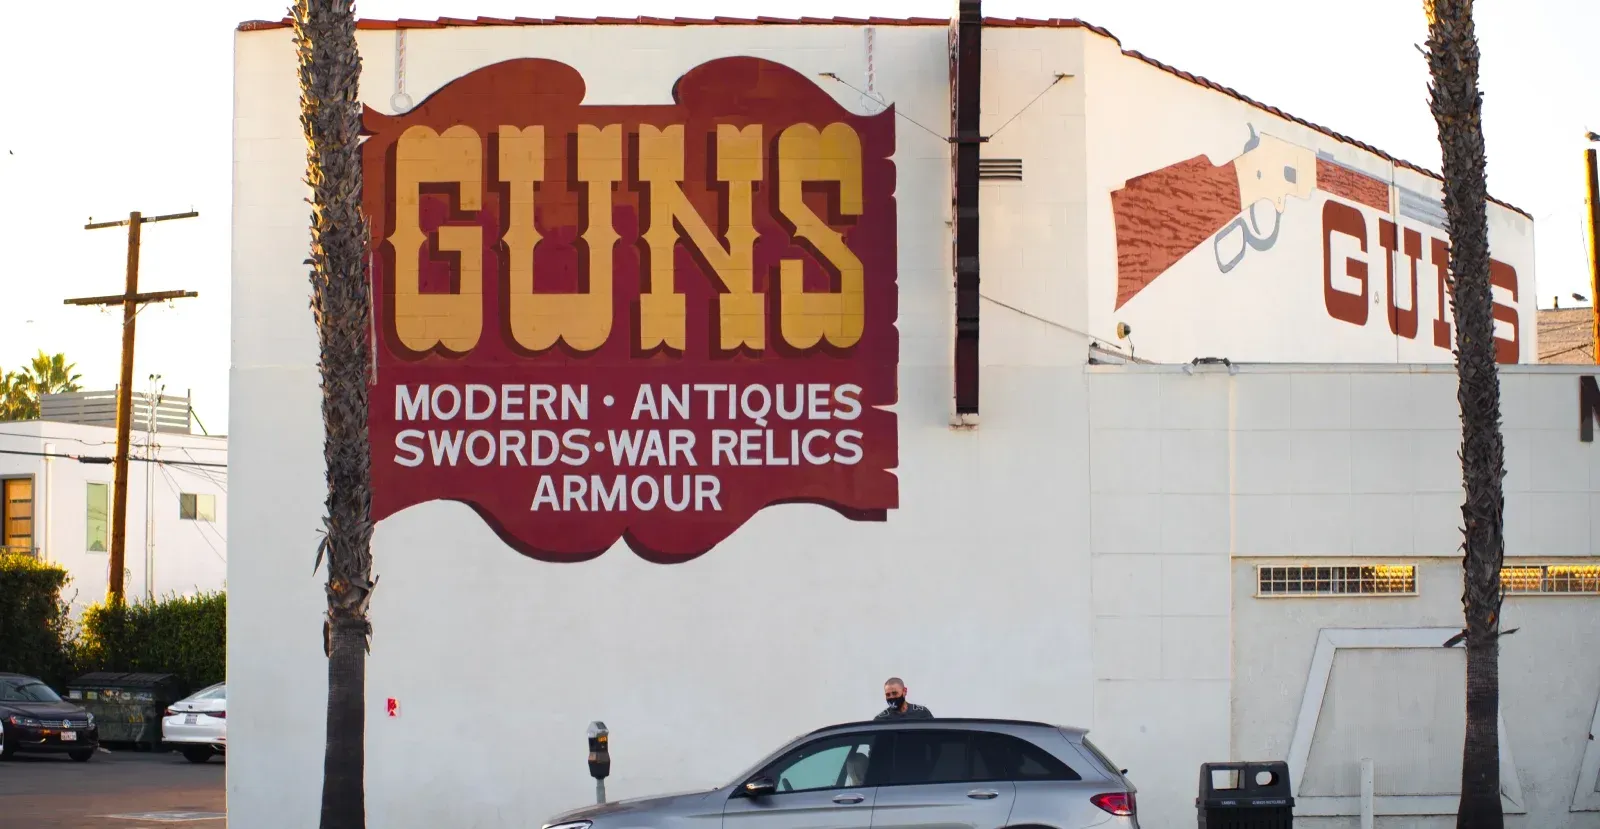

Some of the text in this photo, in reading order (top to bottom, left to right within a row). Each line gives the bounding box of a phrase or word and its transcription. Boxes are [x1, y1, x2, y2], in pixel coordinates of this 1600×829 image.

[385, 122, 865, 353] GUNS
[395, 383, 863, 428] MODERN ANTIQUES
[393, 428, 864, 467] SWORDS WAR RELICS
[530, 474, 722, 512] ARMOUR
